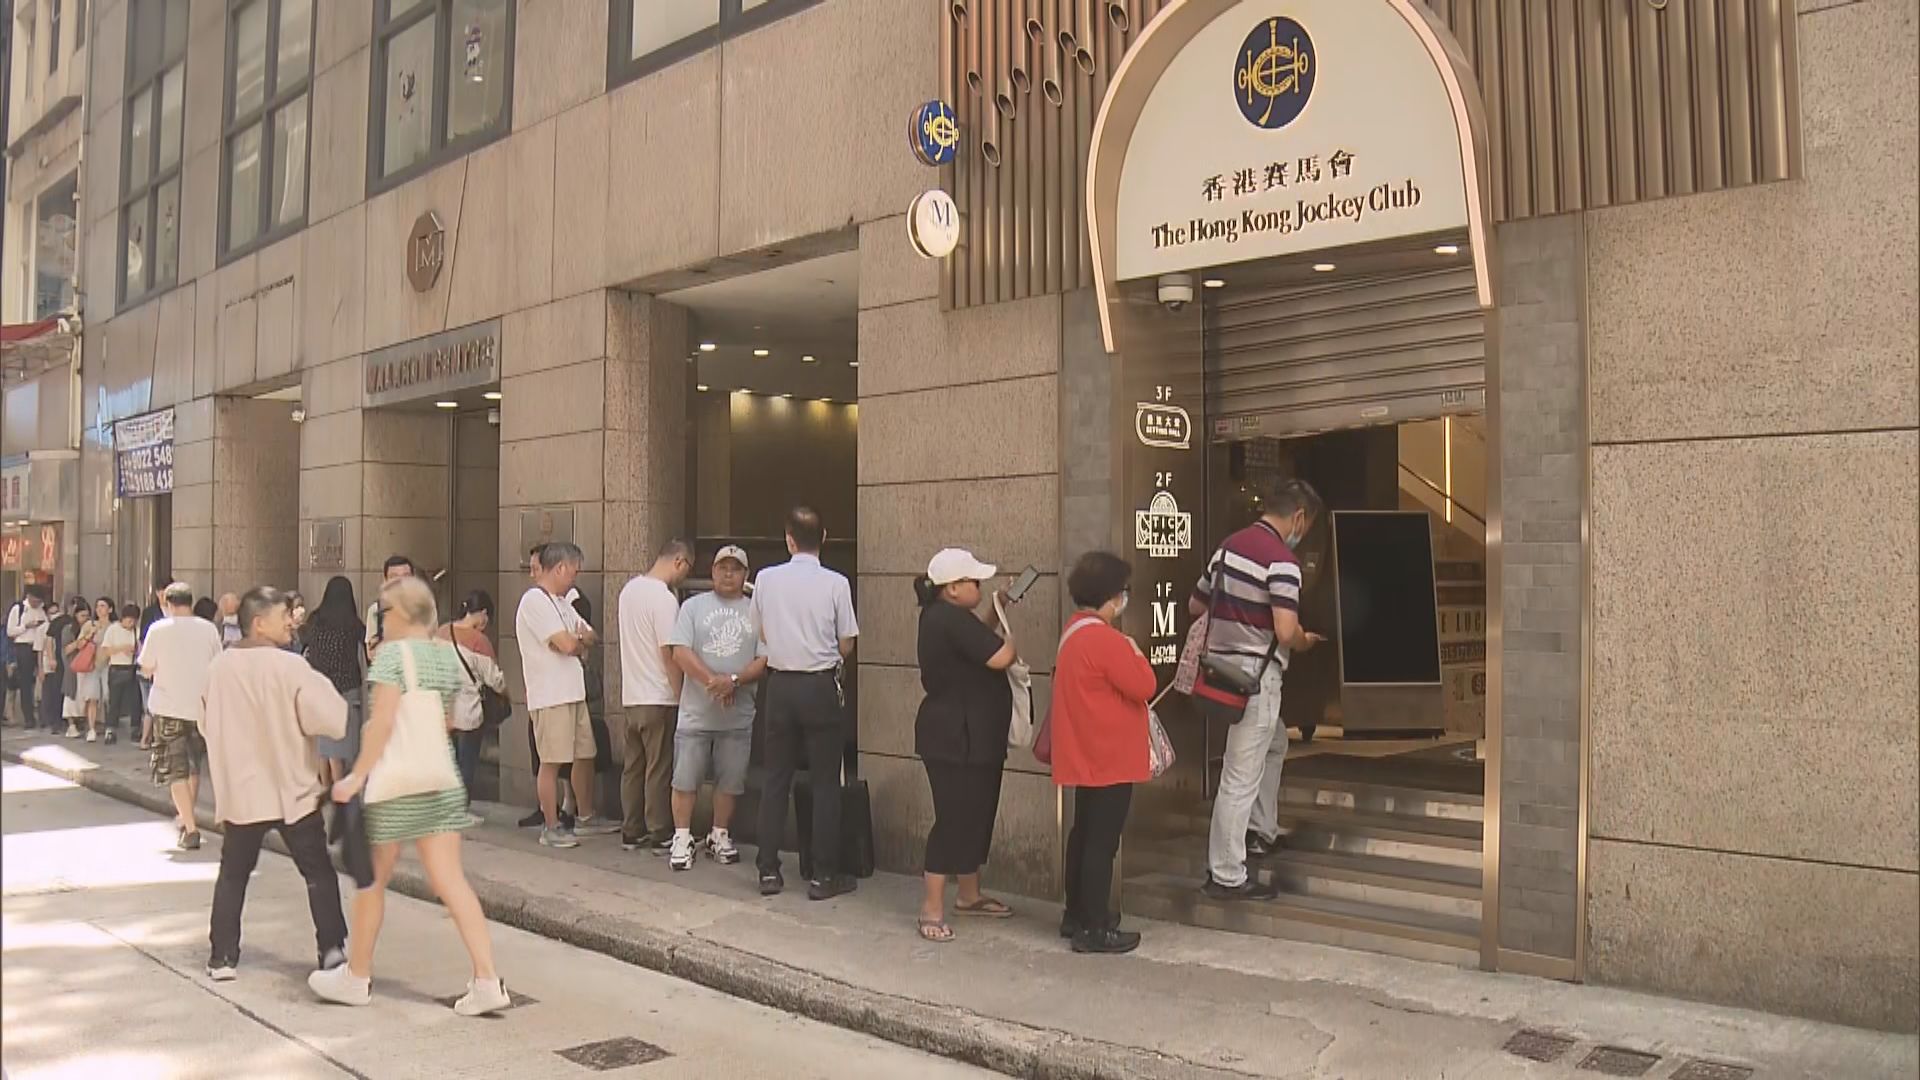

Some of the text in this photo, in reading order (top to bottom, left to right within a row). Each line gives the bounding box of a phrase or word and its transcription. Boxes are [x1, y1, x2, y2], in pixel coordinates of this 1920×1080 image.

[1202, 149, 1355, 202] 香港賽馬會
[1151, 178, 1421, 248] The Hong Kong Jockey Club
[1155, 385, 1172, 401] 3F
[1155, 471, 1172, 487] 2F
[1152, 516, 1175, 529] TIC
[1152, 532, 1175, 545] TAC
[1156, 582, 1172, 597] 1F
[1150, 602, 1177, 637] M
